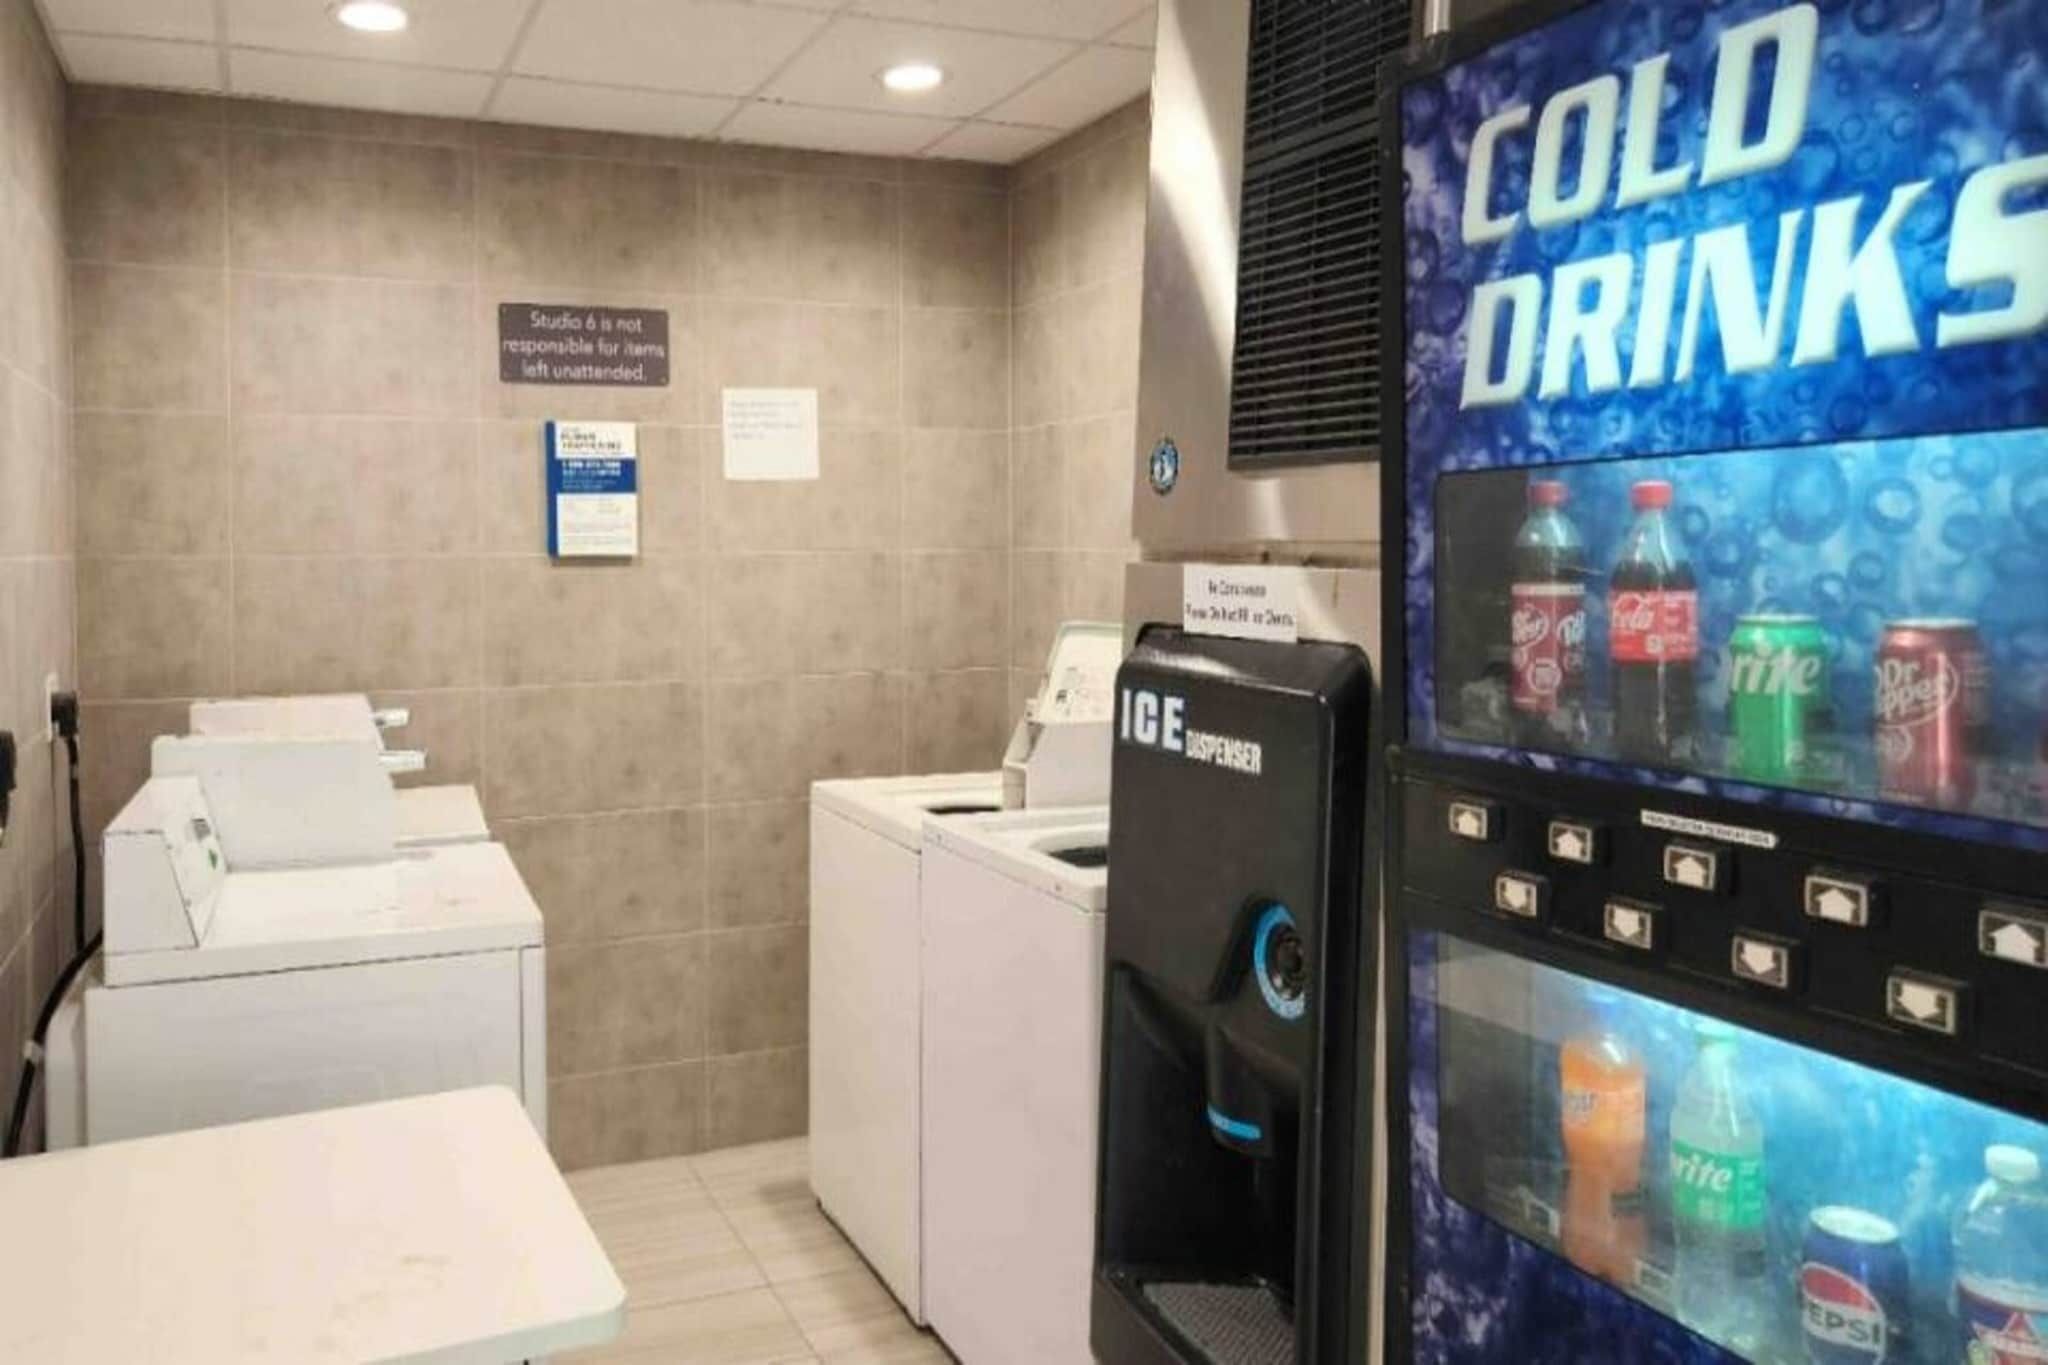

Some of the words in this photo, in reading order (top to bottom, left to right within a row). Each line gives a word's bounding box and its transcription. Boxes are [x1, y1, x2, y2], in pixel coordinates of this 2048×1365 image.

[1461, 4, 1818, 246] COLD
[1459, 153, 2048, 412] DRINKS
[503, 336, 594, 357] responsible
[597, 338, 619, 356] for
[623, 340, 665, 358] items
[530, 311, 582, 331] Studio
[585, 312, 596, 331] 6
[600, 315, 612, 332] is
[616, 317, 643, 333] not
[521, 358, 548, 379] left
[553, 363, 648, 382] unattended.
[1120, 687, 1185, 752] ICE
[1186, 728, 1263, 777] DISPENSER
